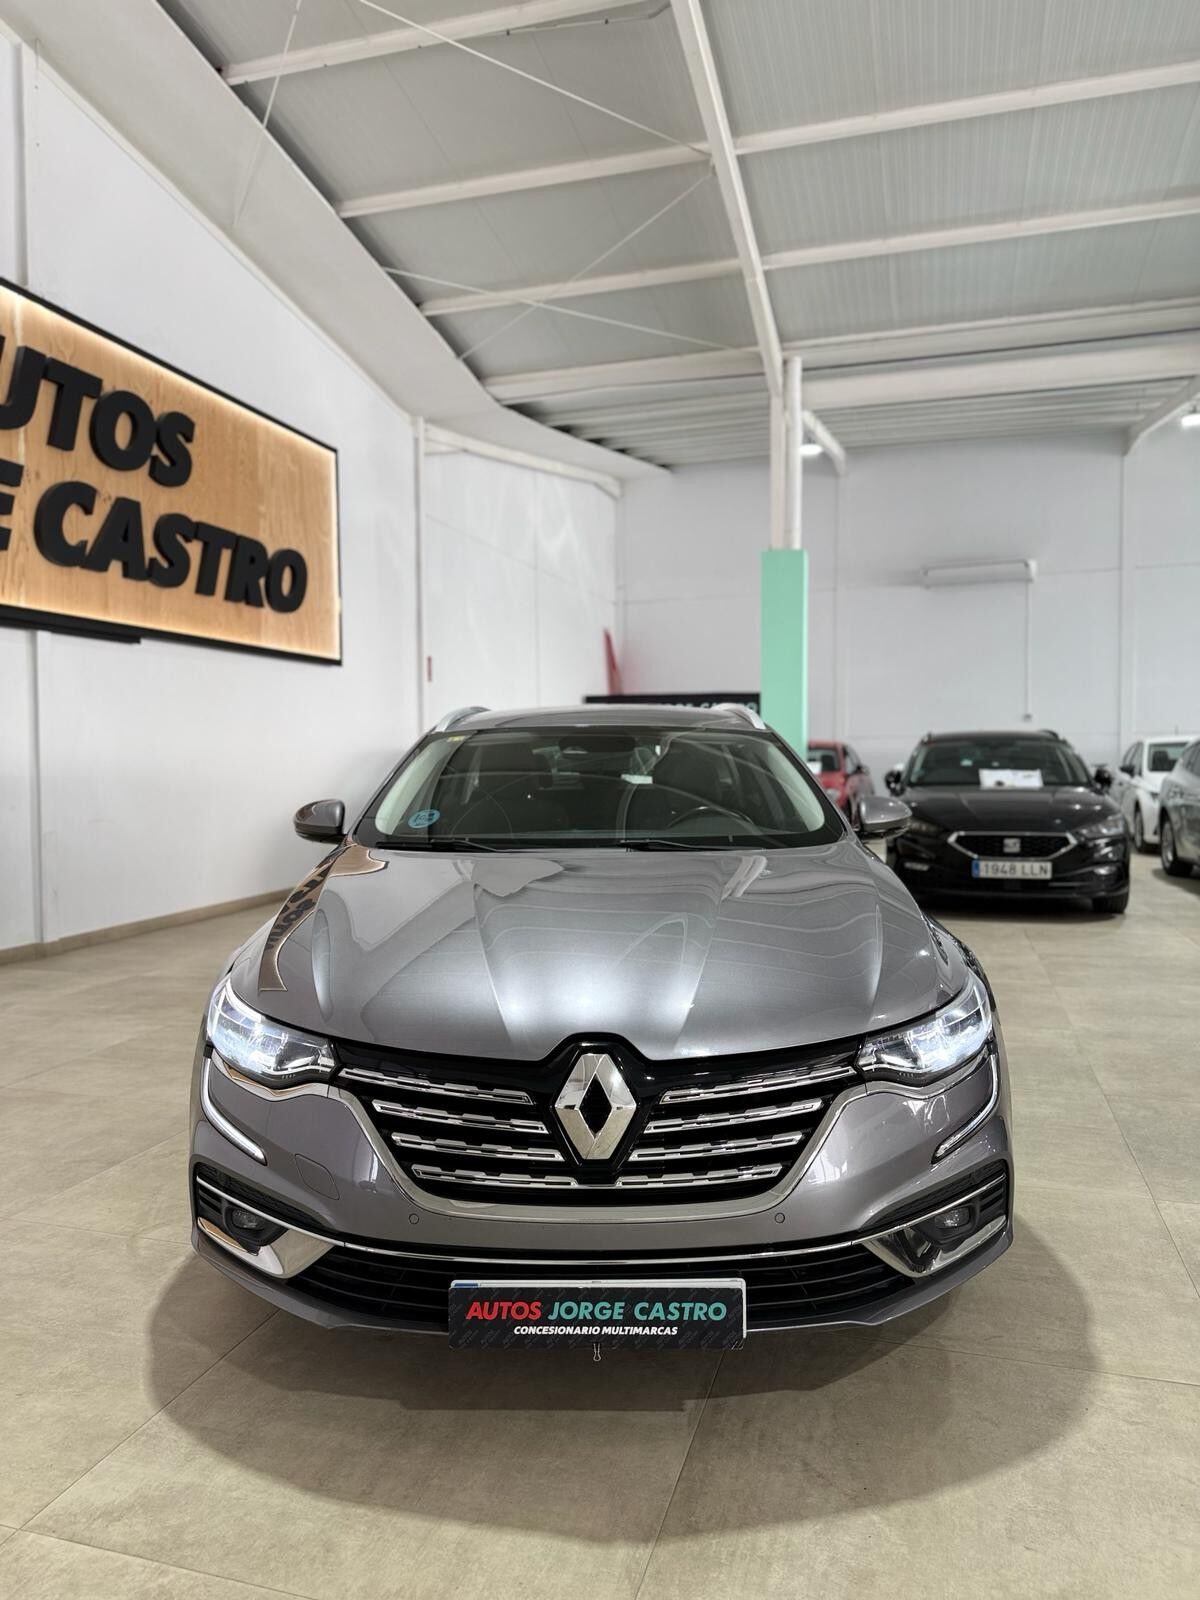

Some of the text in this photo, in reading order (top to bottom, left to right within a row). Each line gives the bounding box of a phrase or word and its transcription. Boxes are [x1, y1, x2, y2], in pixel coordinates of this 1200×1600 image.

[0, 336, 195, 487] UTOS
[33, 481, 307, 614] CASTRO
[984, 863, 1048, 877] 1948 LLN
[465, 1301, 727, 1321] AUTOS JORGE CASTRO
[513, 1326, 678, 1335] CONCESIONARIO MULTIMARCAS
